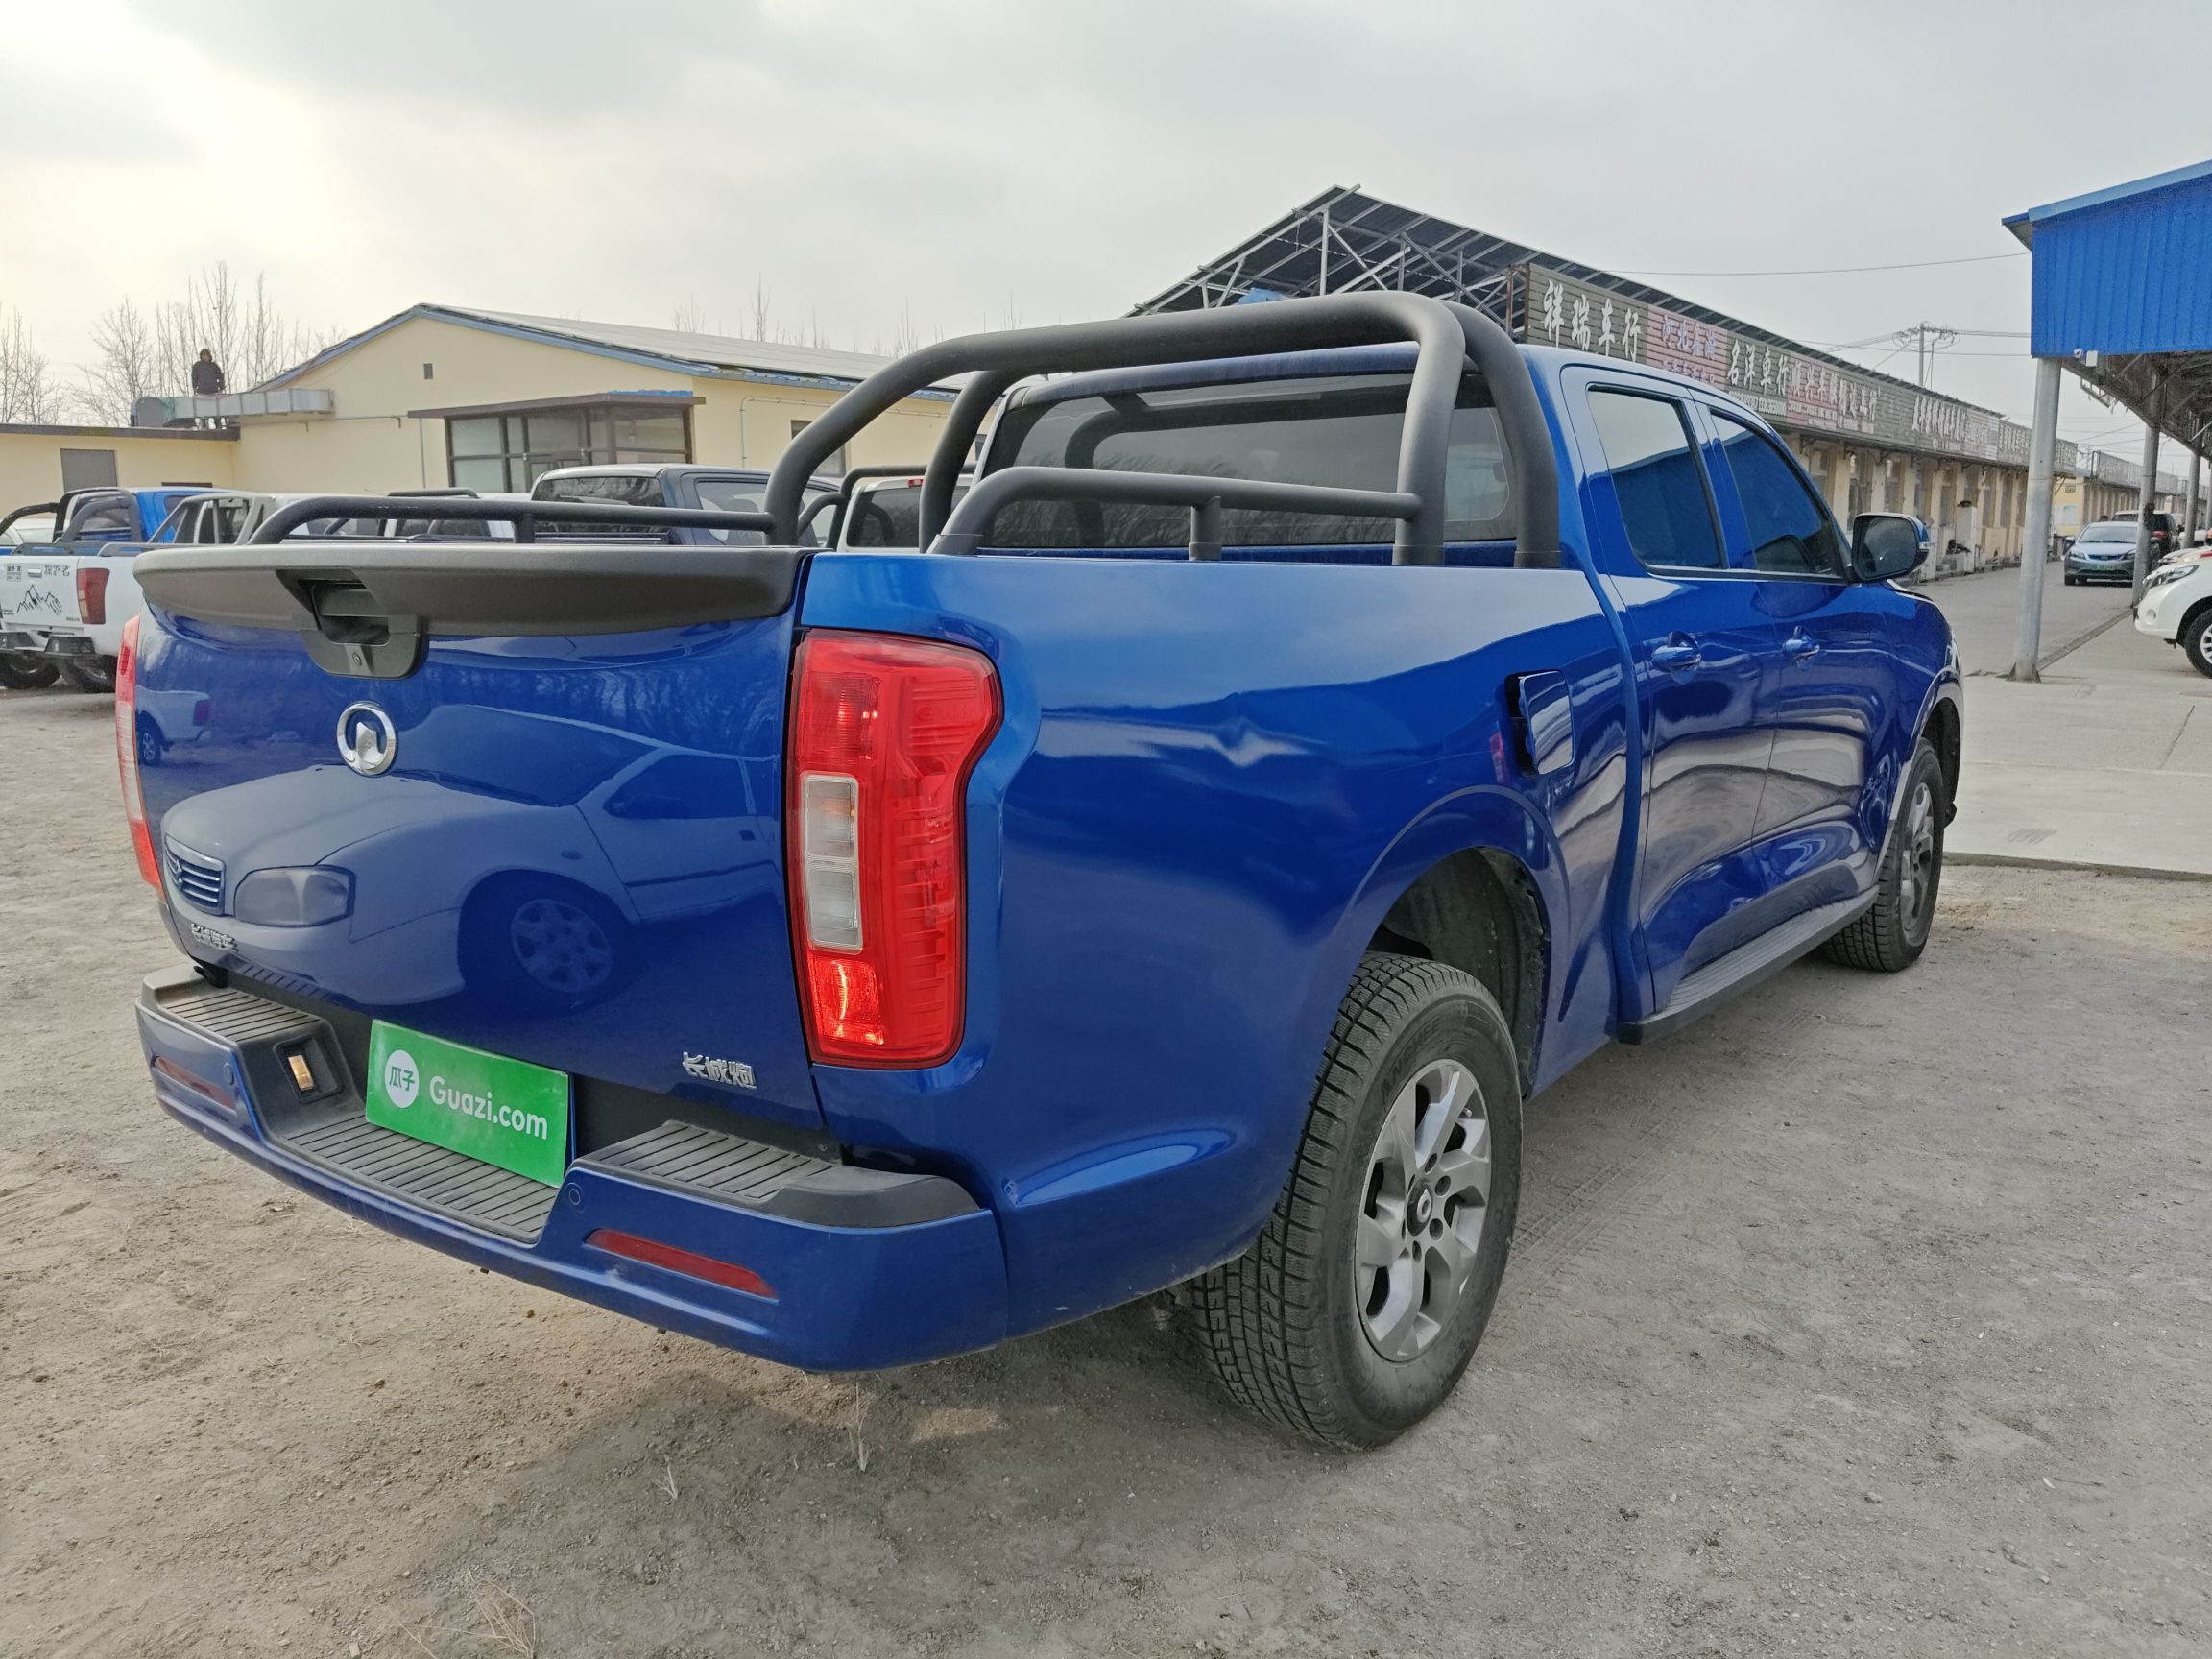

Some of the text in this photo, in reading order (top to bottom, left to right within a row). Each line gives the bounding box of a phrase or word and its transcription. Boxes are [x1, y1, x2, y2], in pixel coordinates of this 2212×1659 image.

[388, 1065, 416, 1092] 瓜子
[682, 1051, 757, 1089] 长城炮
[429, 1075, 548, 1140] Guazi.com
